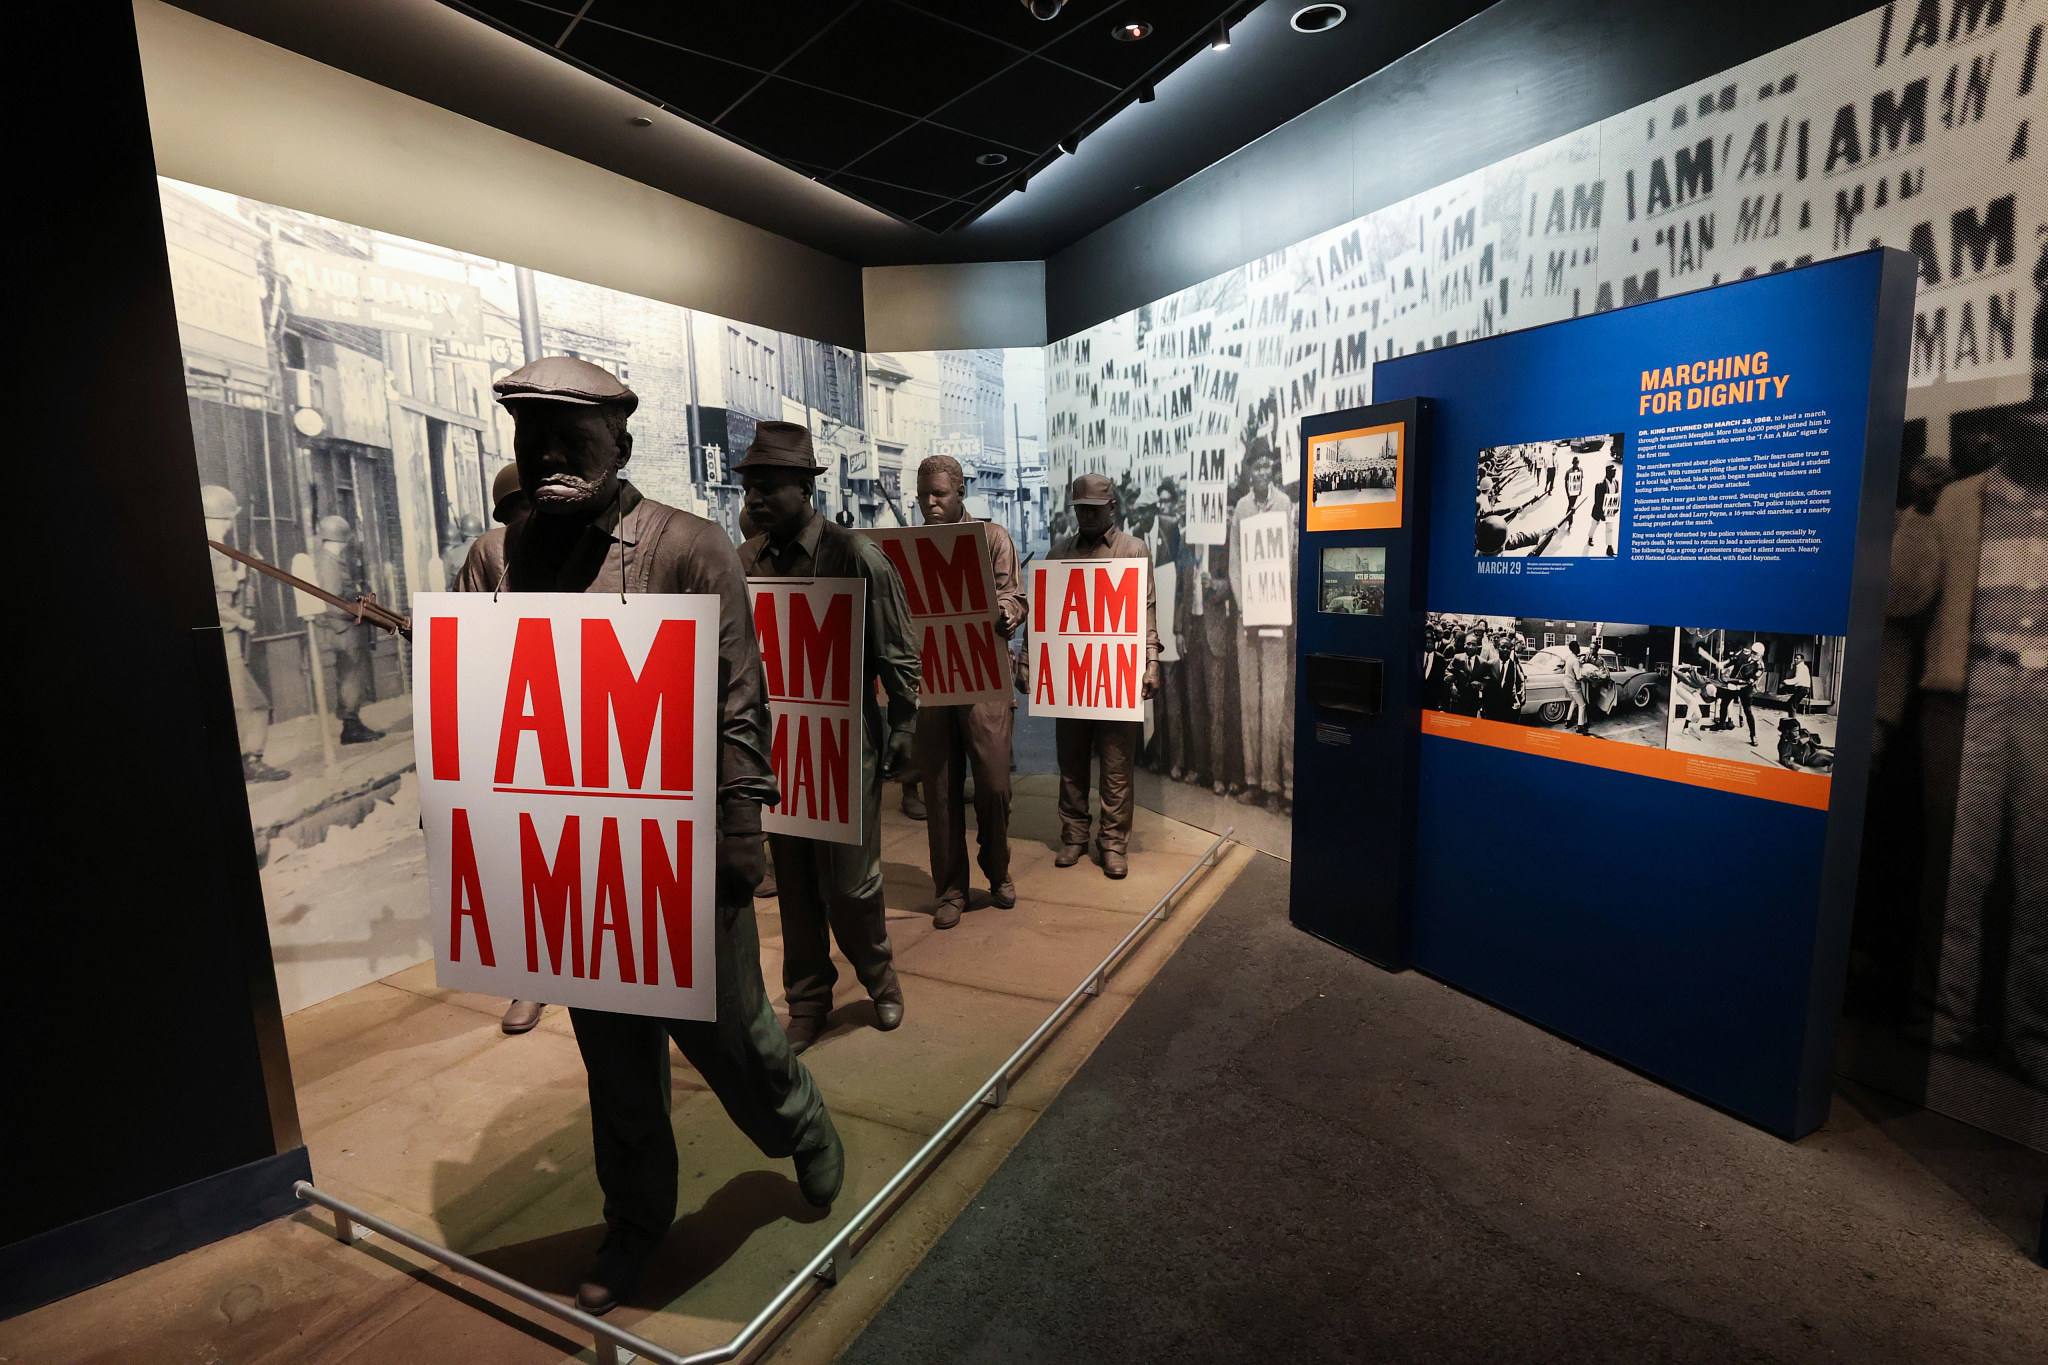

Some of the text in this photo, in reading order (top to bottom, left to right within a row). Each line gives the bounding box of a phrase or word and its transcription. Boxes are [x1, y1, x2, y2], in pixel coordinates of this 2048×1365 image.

[1646, 136, 1714, 216] AM
[1543, 180, 1606, 236] AM
[1328, 229, 1364, 282] AM
[1188, 321, 1212, 358] AM
[1331, 330, 1367, 378] AM
[1210, 369, 1239, 404] AM
[1641, 351, 1769, 392] MARCHING
[1171, 384, 1192, 420] AM
[1639, 375, 1790, 416] FOR DIGNITY
[1088, 418, 1106, 449] AM
[1667, 424, 1702, 434] RETURNED
[1715, 420, 1740, 428] MARCH
[1805, 410, 1826, 419] march
[1748, 425, 1764, 433] 6,000
[1766, 423, 1786, 433] people
[1788, 420, 1807, 430] joined
[1143, 429, 1163, 458] AM
[1190, 448, 1225, 482] I AM
[1750, 463, 1767, 472] police
[1201, 492, 1224, 524] MAN
[1735, 508, 1766, 518] 16-year-old
[1809, 506, 1831, 515] nearby
[1740, 493, 1768, 501] Swinging
[1766, 500, 1784, 508] police
[1785, 498, 1808, 507] injured
[1254, 527, 1285, 562] AM
[1718, 530, 1735, 538] police
[1776, 529, 1807, 537] especially
[1733, 546, 1751, 554] staged
[1798, 546, 1819, 554] Nearly
[1477, 561, 1521, 574] MARCH 29
[1034, 567, 1139, 633] I AM
[1259, 571, 1287, 603] MAN
[753, 593, 853, 700] AM
[1036, 642, 1137, 709] A MAN
[430, 617, 696, 791] I AM
[450, 808, 694, 989] A MAN
